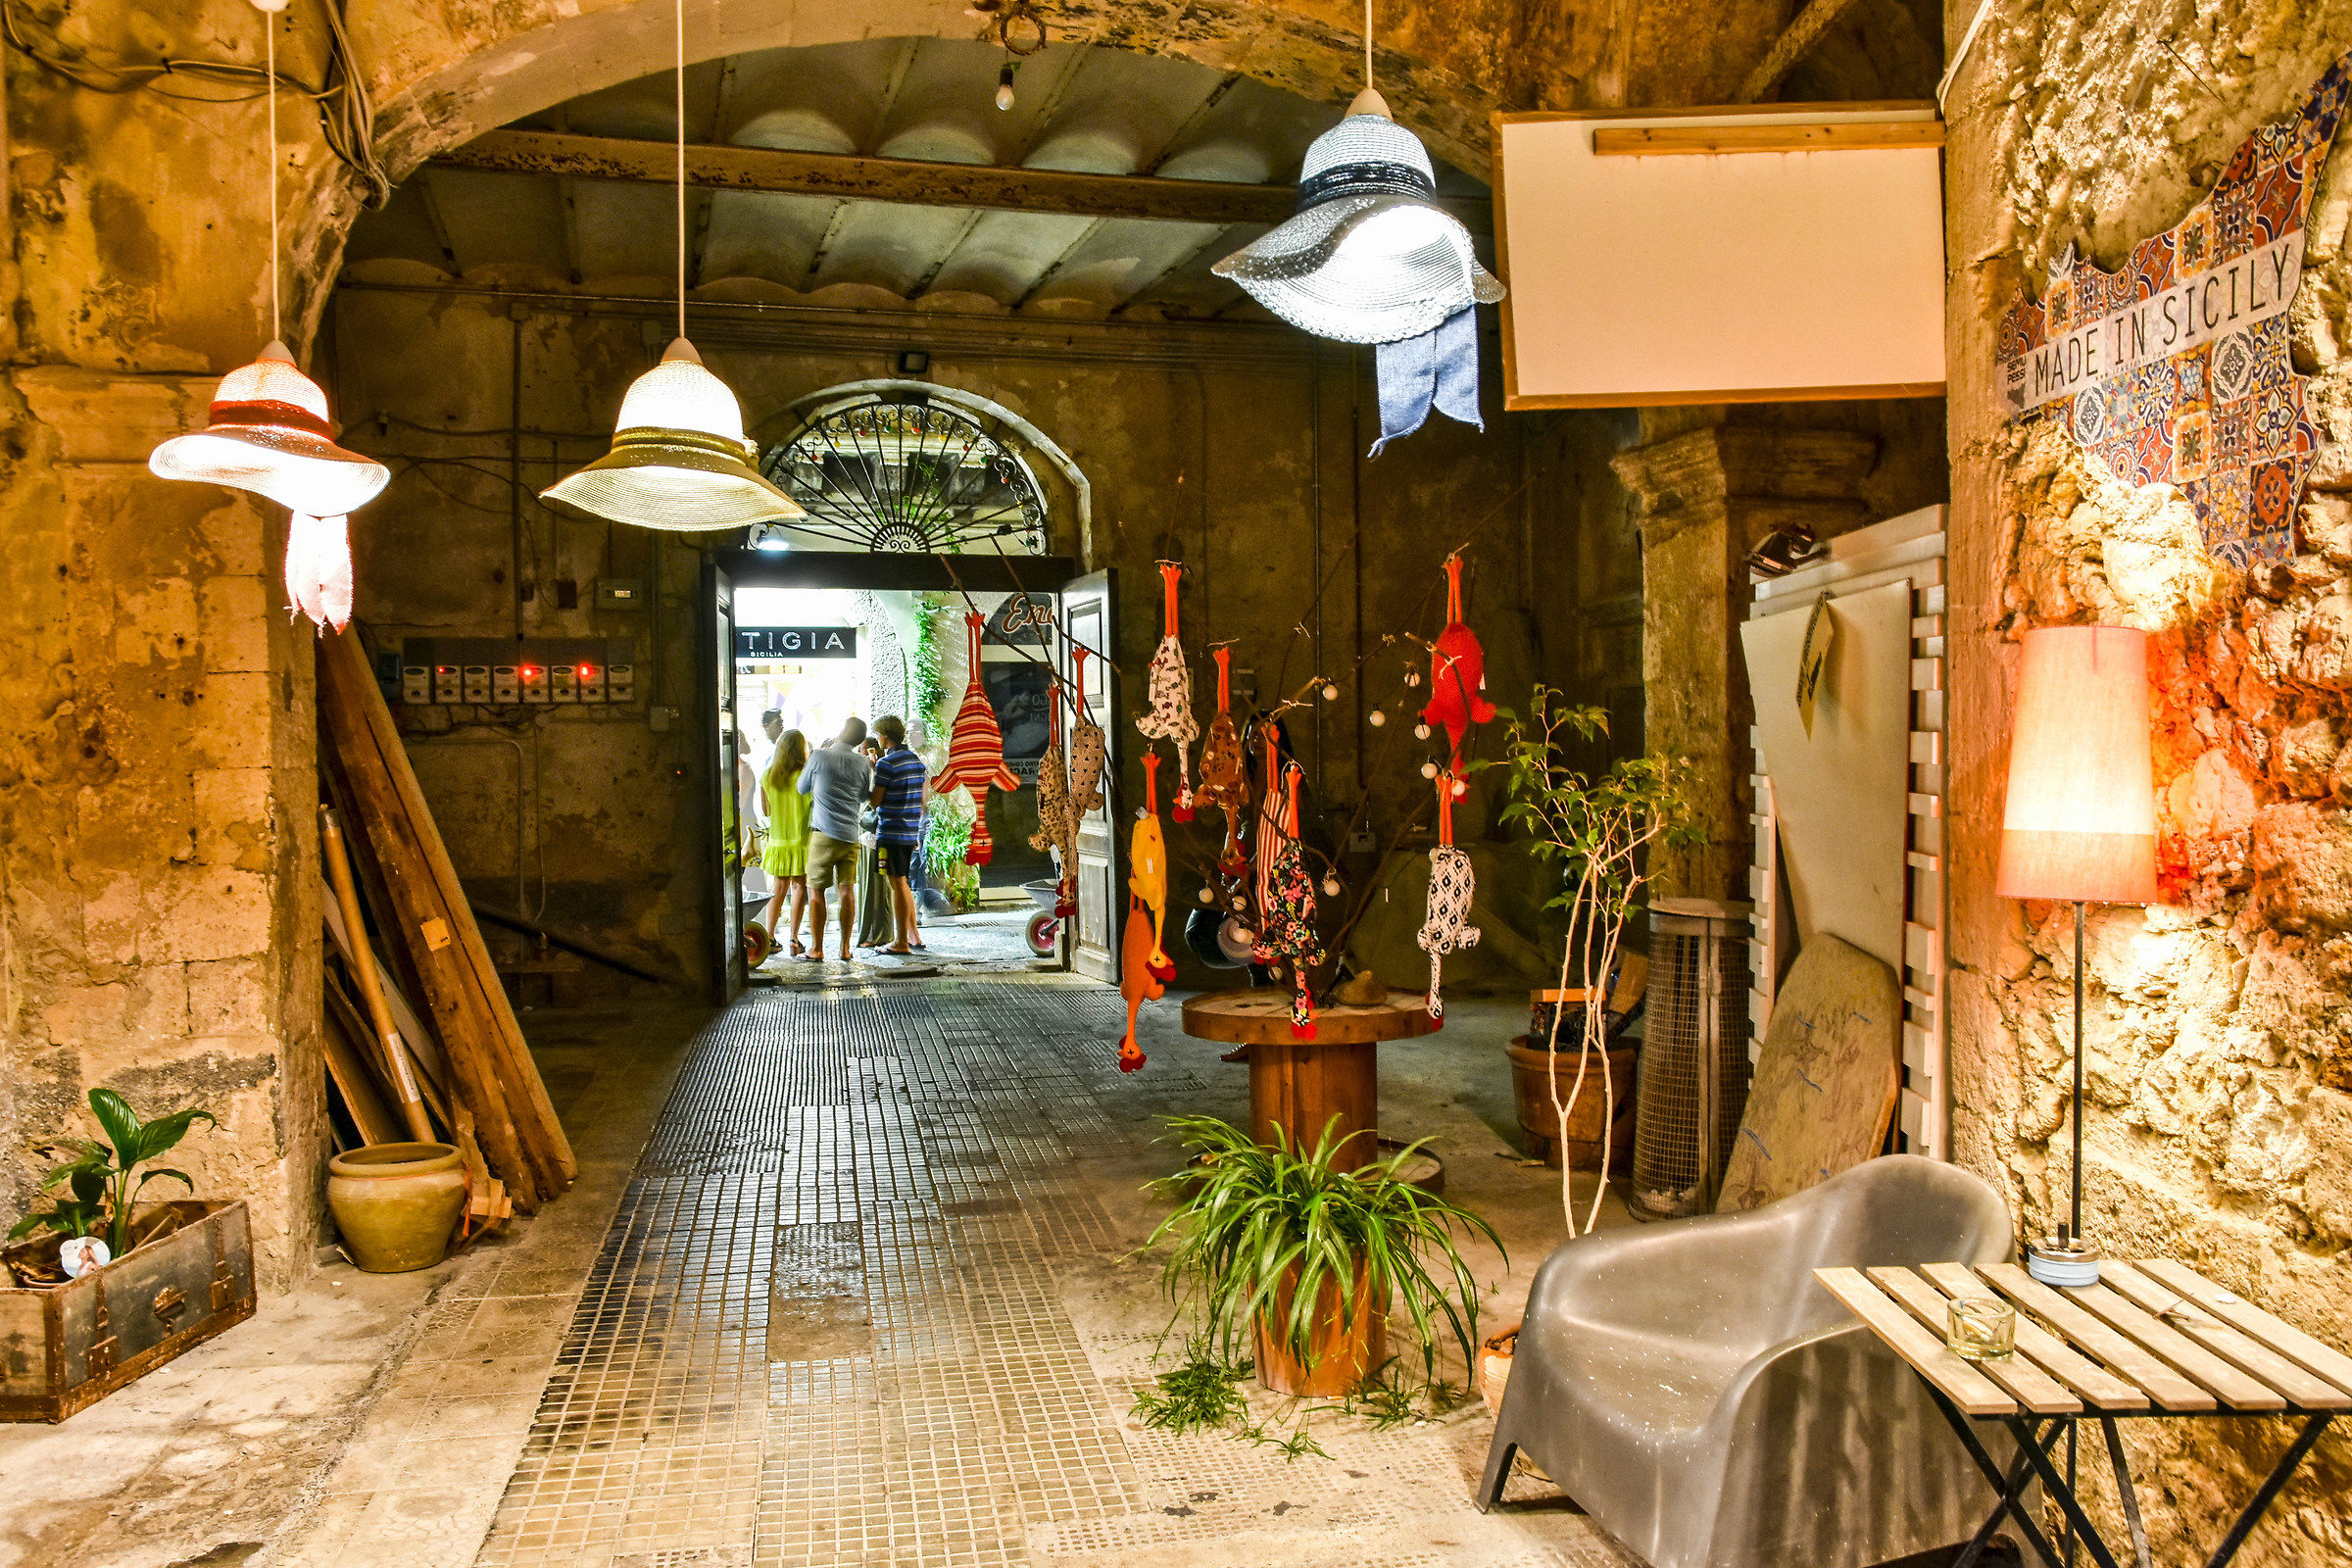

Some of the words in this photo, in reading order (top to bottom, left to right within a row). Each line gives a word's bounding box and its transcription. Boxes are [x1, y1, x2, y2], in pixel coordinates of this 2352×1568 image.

[2035, 327, 2099, 397] MADE
[2114, 308, 2145, 366] IN
[2162, 243, 2290, 346] SICILY
[741, 631, 845, 650] TIGIA
